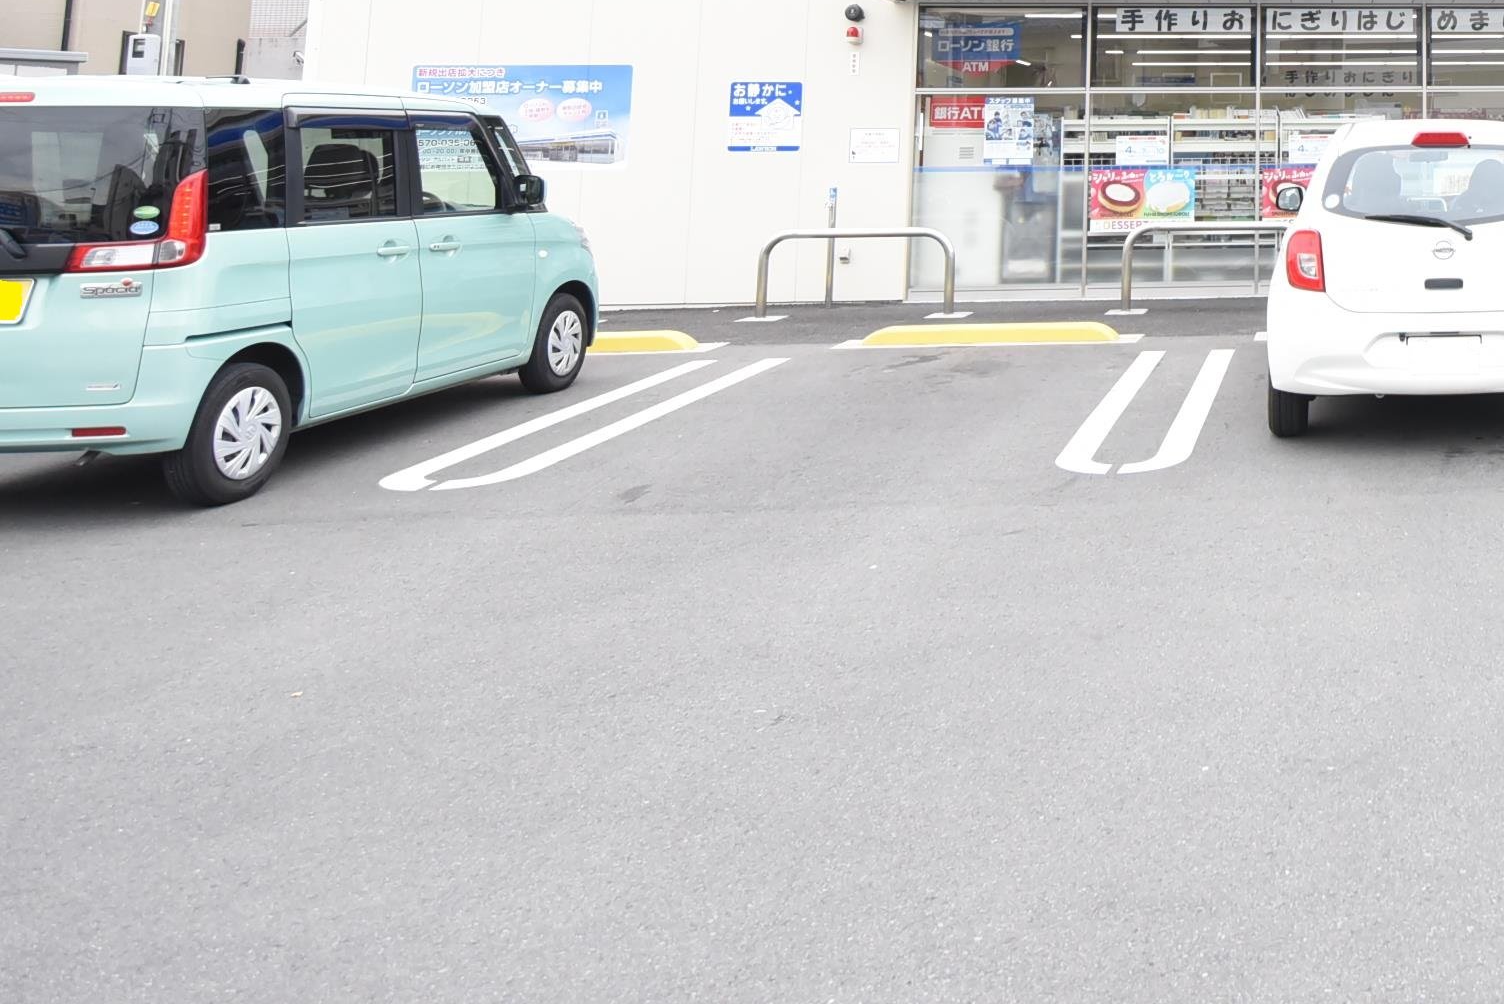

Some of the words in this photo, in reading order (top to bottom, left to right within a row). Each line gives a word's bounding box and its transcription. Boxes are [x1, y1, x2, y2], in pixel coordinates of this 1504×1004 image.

[937, 38, 1015, 53] ローソン銀行
[418, 67, 505, 78] 新規出店拡大につき
[961, 61, 990, 73] ATM
[1284, 70, 1413, 84] 手作りおにぎり
[416, 80, 604, 95] ローソン加盟店オーナー募集中
[732, 83, 787, 98] お静かに
[933, 106, 986, 121] 銀行AT
[1103, 220, 1149, 230] DESSER
